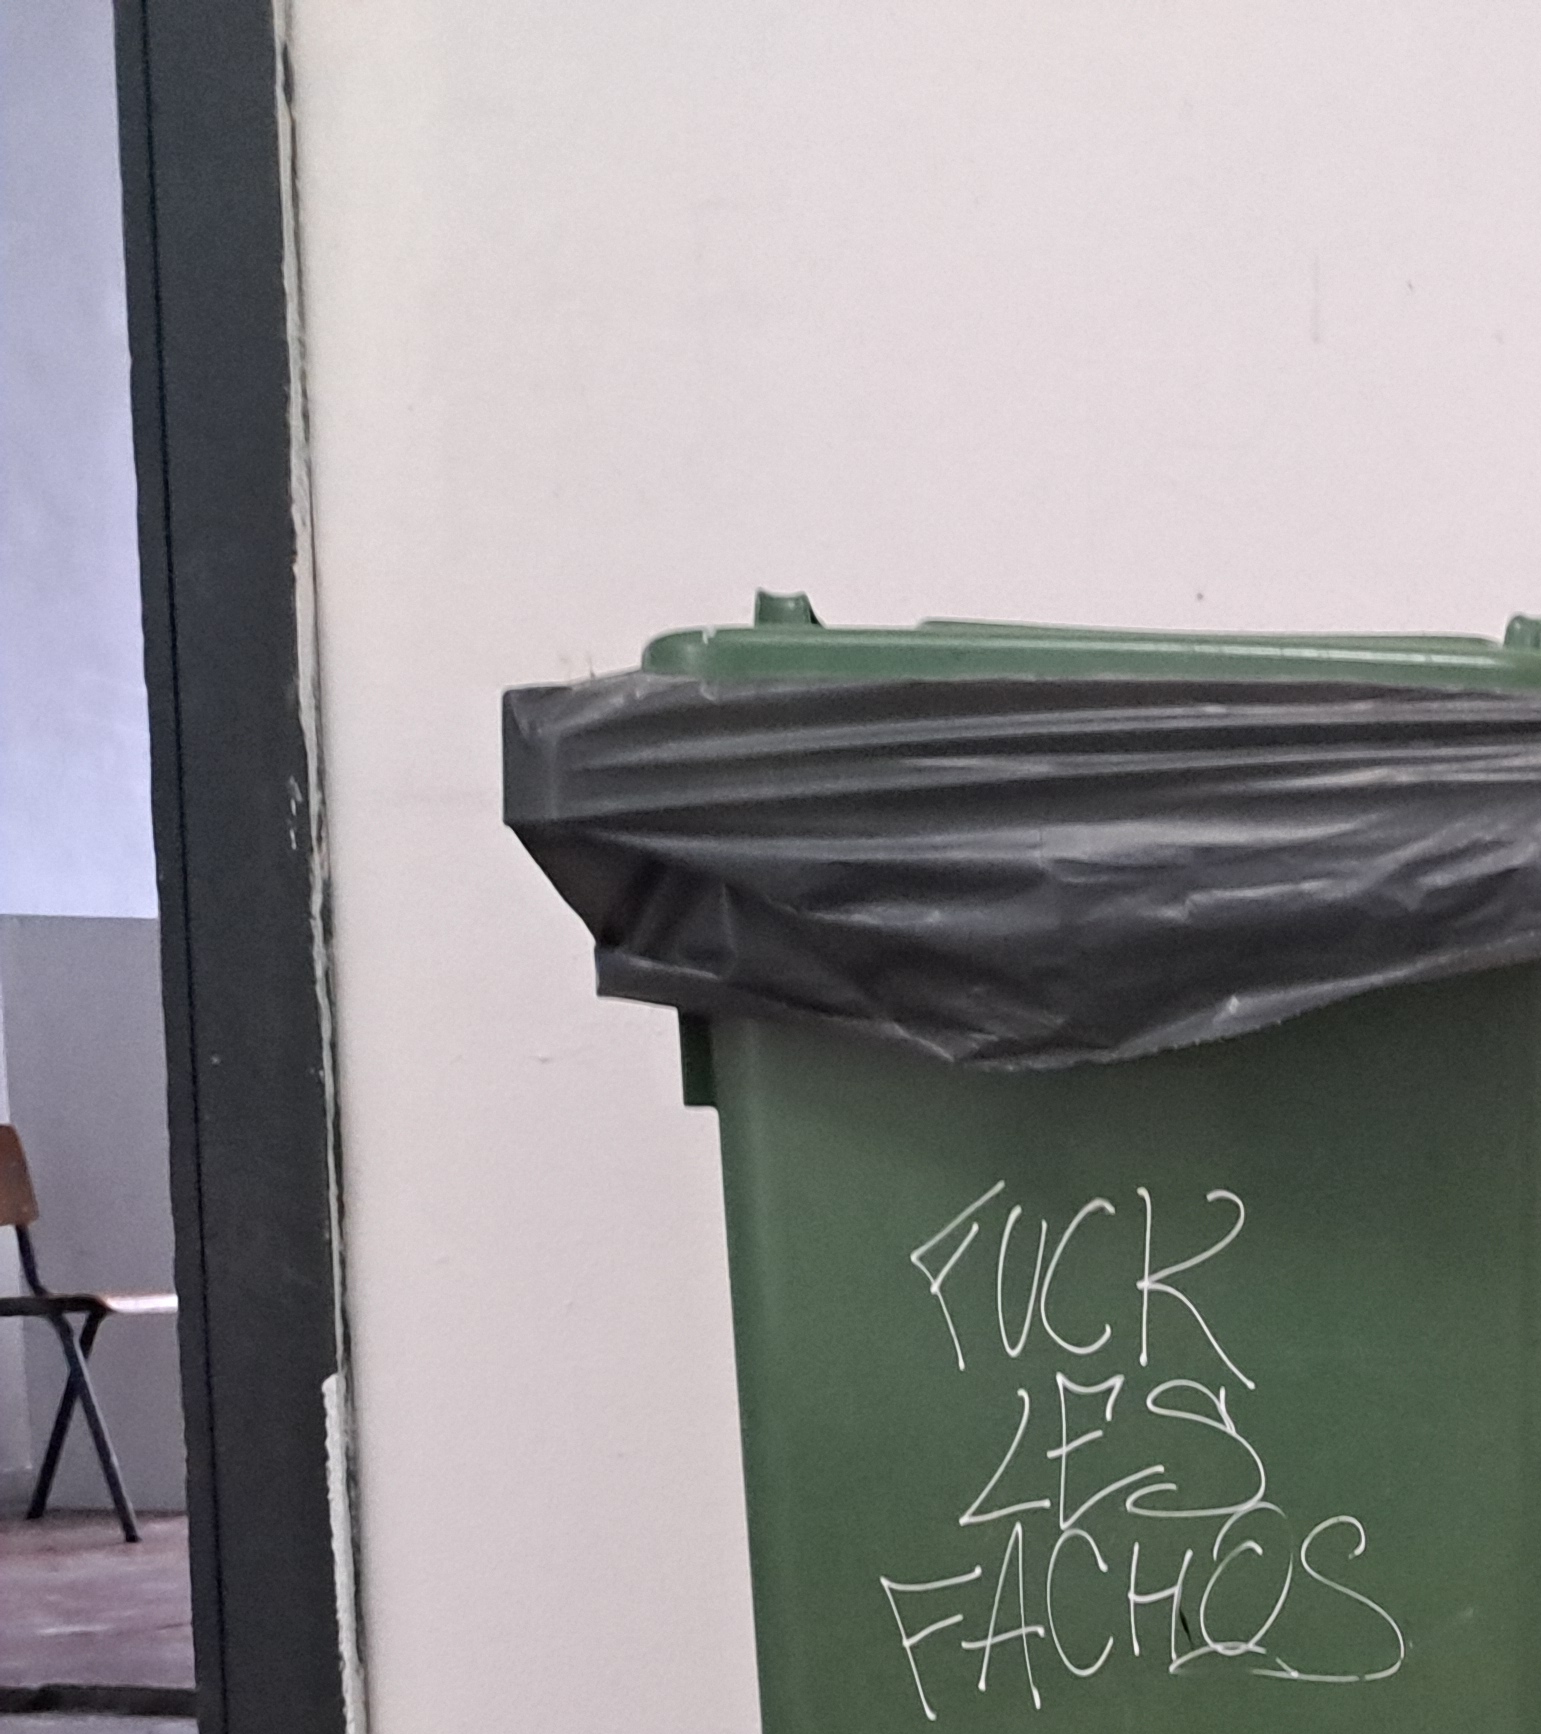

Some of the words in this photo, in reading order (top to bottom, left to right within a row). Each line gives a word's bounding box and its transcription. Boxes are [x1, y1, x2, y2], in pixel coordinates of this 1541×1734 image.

[910, 1179, 1256, 1390] FUCK
[958, 1371, 1266, 1531] LES
[880, 1500, 1406, 1721] FACHOS
